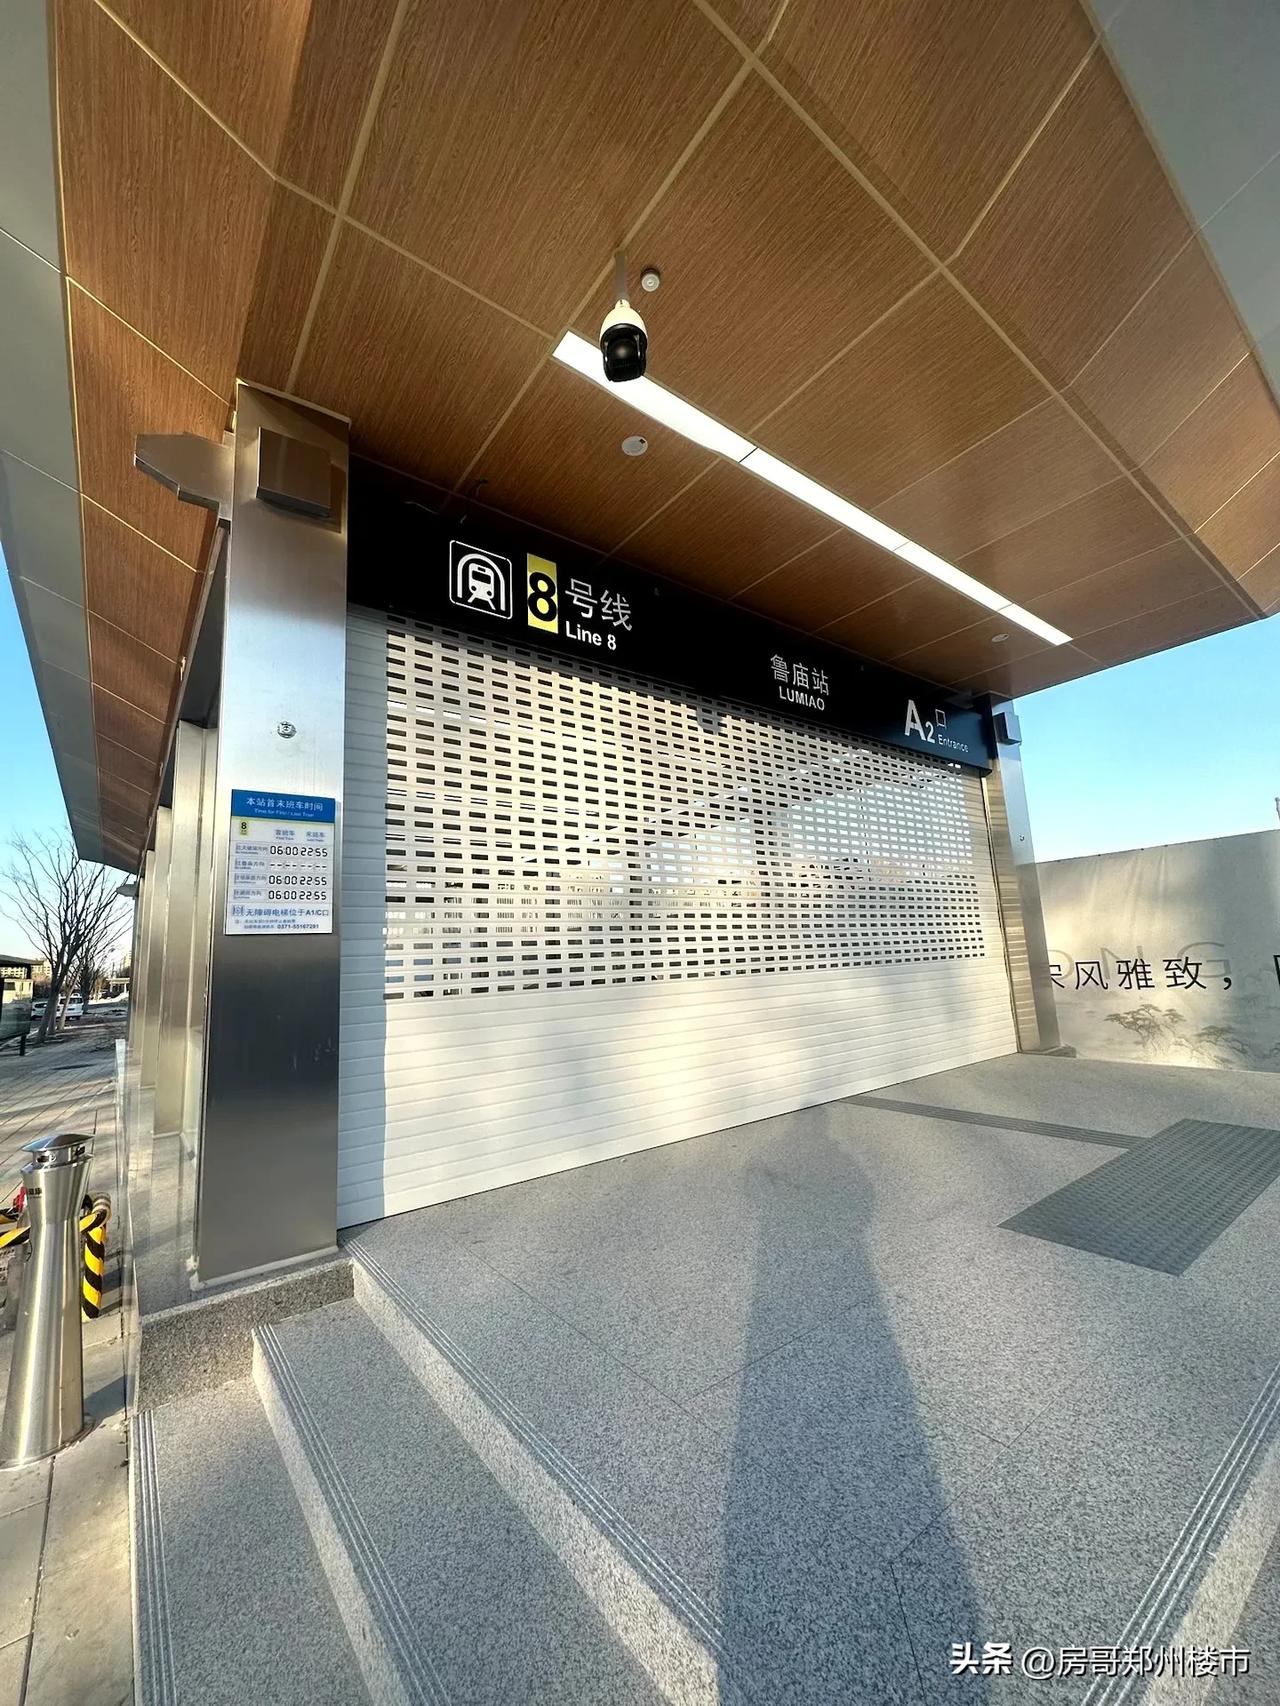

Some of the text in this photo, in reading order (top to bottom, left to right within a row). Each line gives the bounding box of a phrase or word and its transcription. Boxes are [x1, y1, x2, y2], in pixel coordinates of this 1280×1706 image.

[565, 620, 617, 651] Line 8
[770, 654, 830, 696] 鲁庙站
[778, 685, 825, 711] LUMIAO
[937, 734, 969, 753] Entrance
[246, 797, 324, 812] 本站首末班车时间
[240, 821, 248, 830] 8
